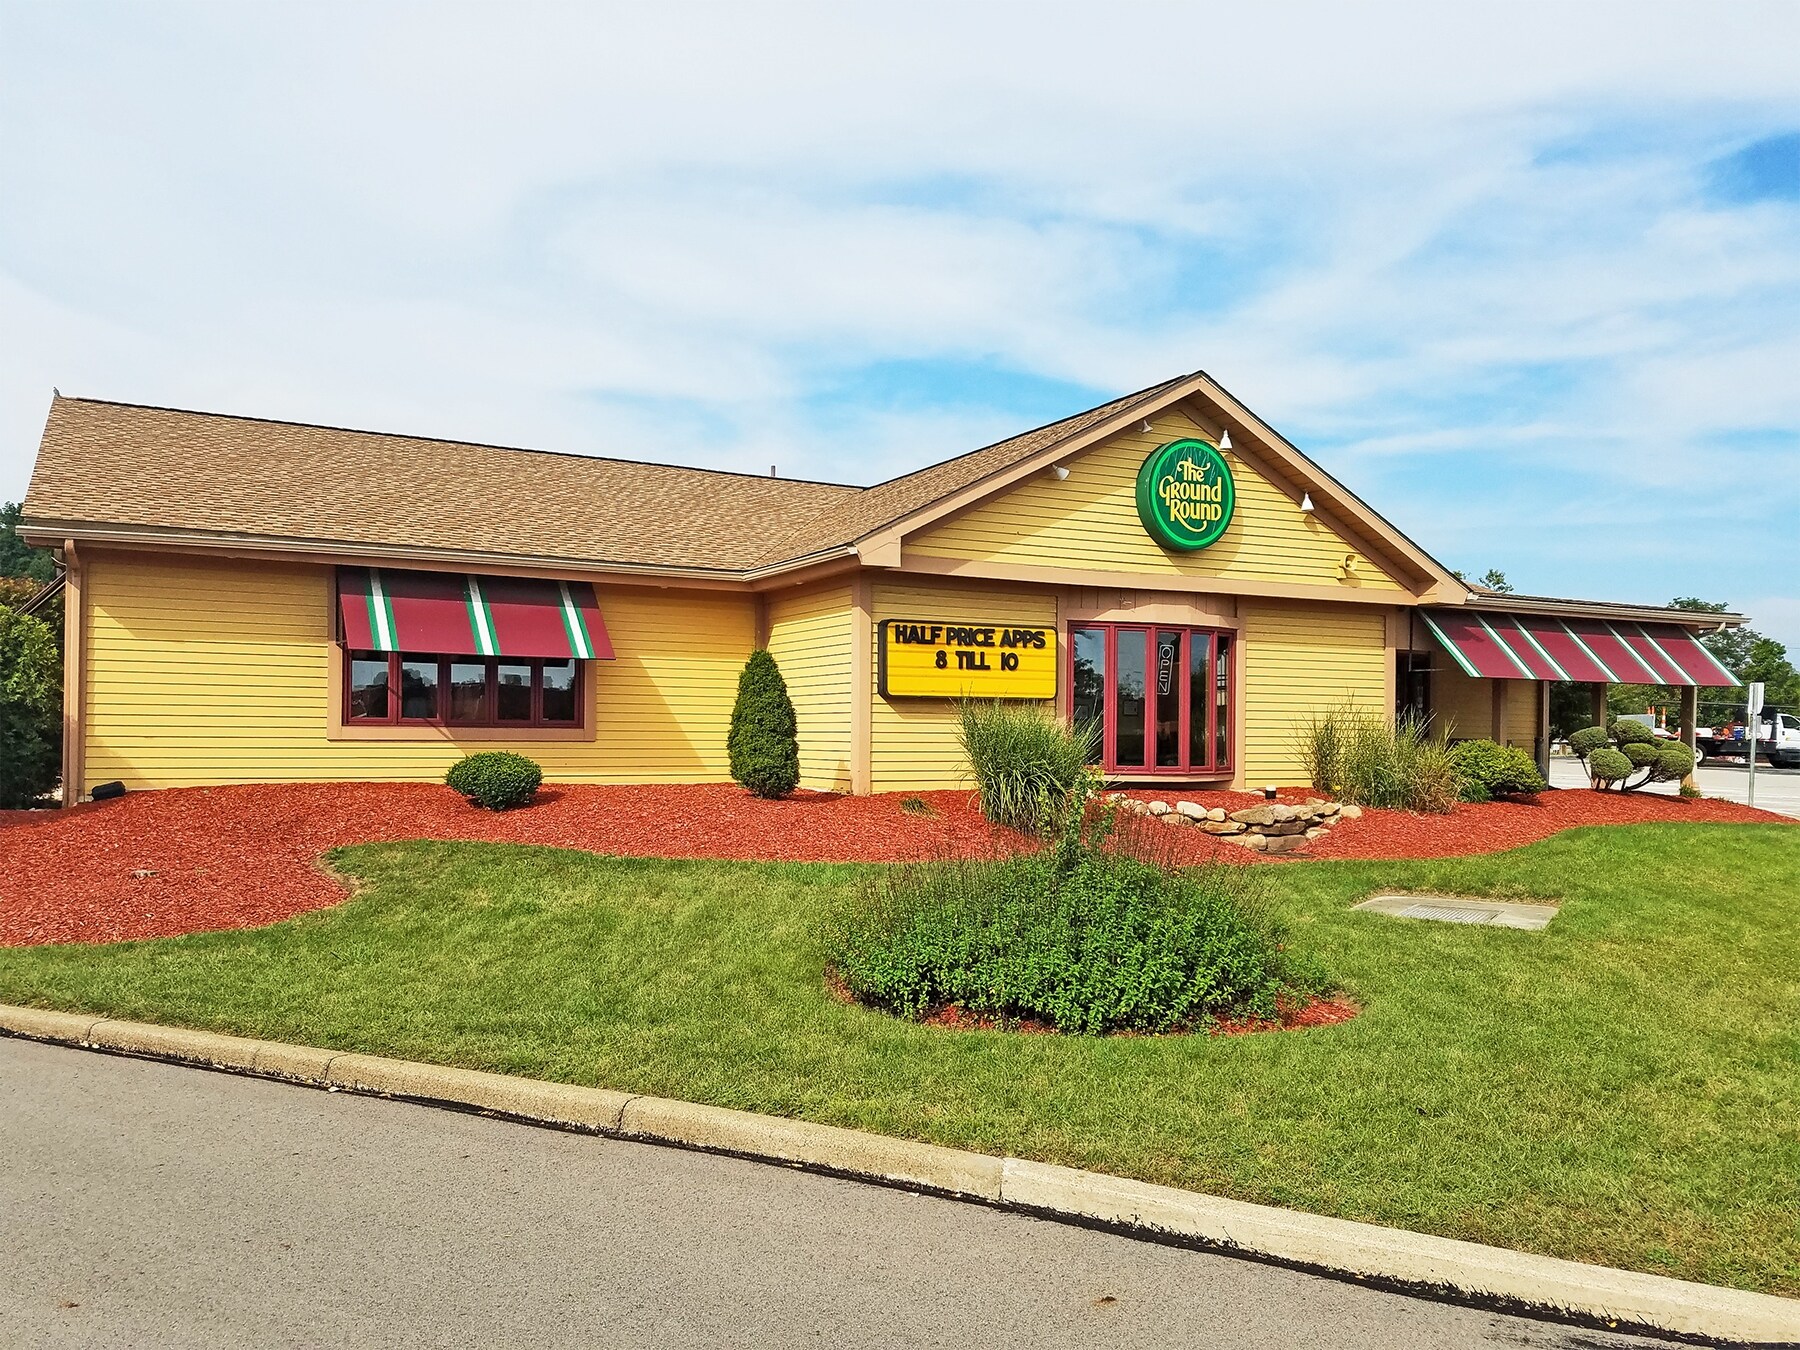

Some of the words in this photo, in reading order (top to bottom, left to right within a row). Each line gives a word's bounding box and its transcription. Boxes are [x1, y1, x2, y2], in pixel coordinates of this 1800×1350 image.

[1177, 457, 1211, 482] The
[895, 624, 943, 645] HALF
[946, 627, 996, 648] PRICE
[1000, 629, 1046, 649] APPS
[935, 650, 948, 669] 8
[955, 650, 991, 671] TILL
[1001, 652, 1019, 671] 10
[1158, 646, 1174, 693] OPEN
